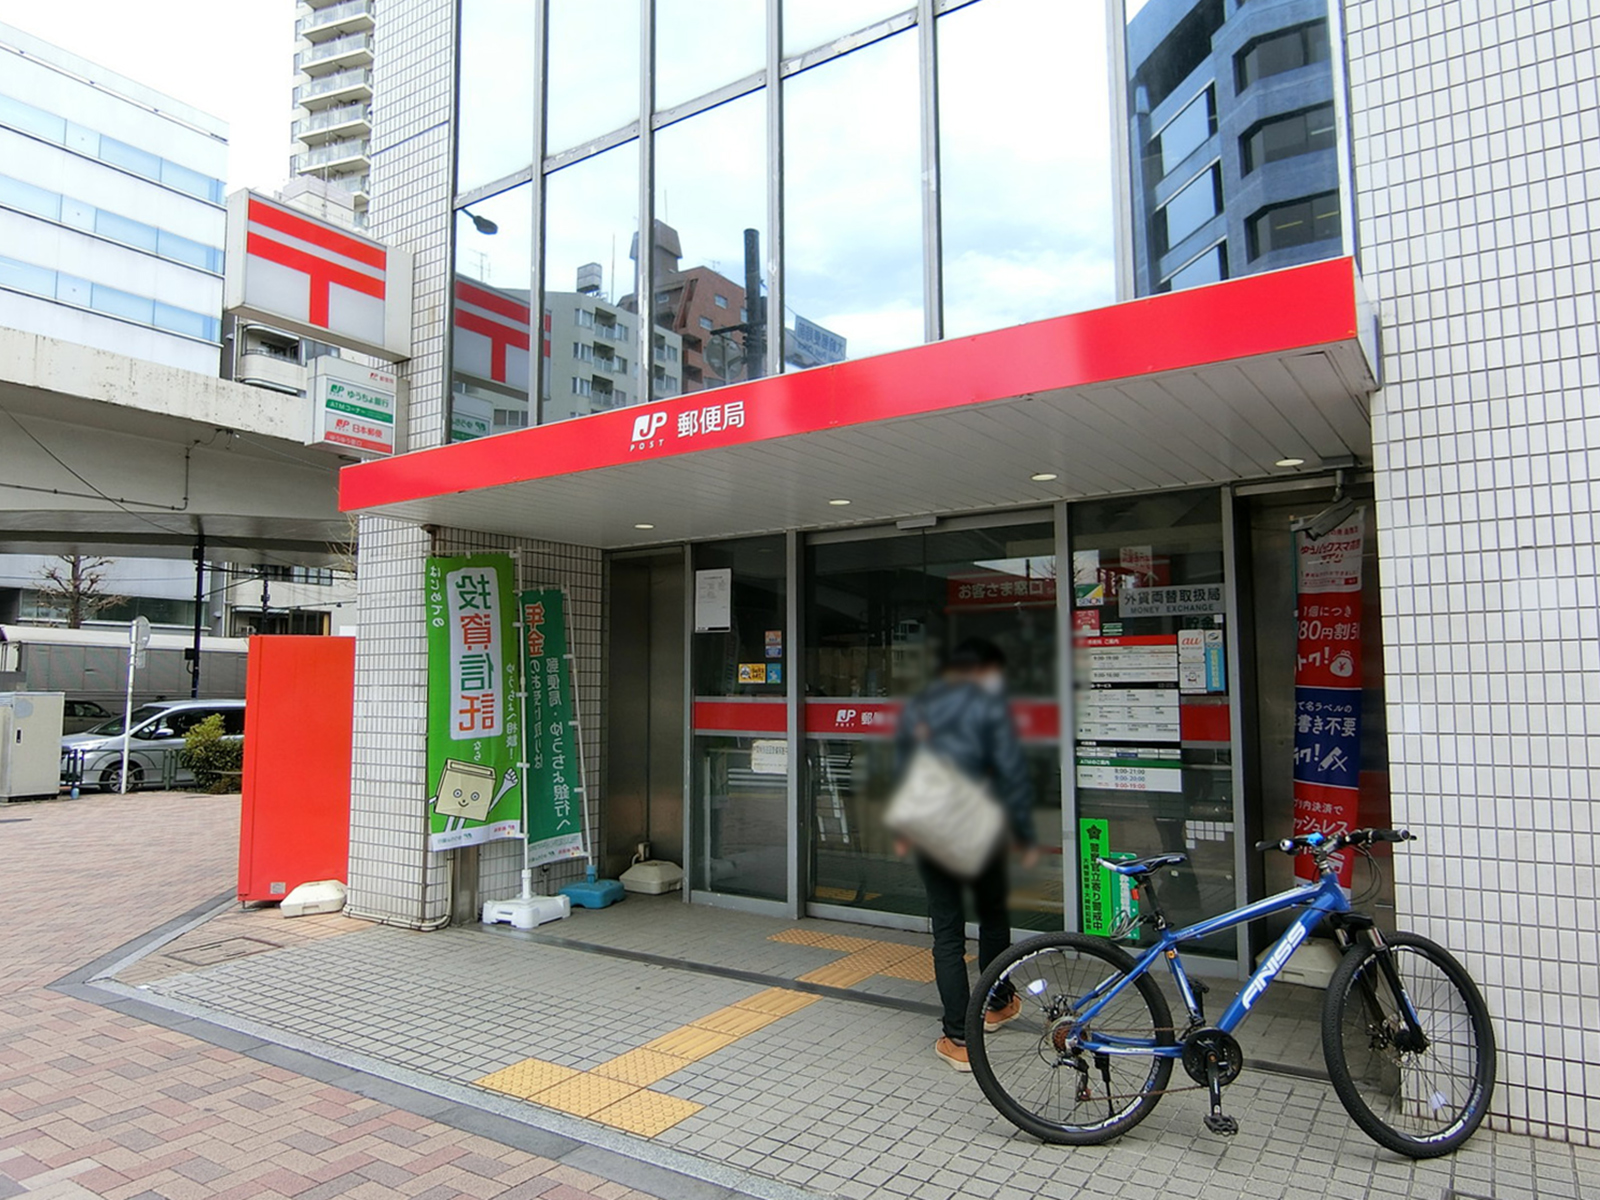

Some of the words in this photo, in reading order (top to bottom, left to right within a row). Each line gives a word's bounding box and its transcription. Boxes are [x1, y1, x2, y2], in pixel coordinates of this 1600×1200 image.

[347, 390, 389, 408] ゆうちょ銀行
[632, 411, 668, 442] JP
[677, 401, 745, 438] 郵便局
[352, 423, 383, 438] 日本郵便
[629, 439, 664, 452] POST
[958, 580, 1044, 599] お客さま窓口
[1124, 587, 1221, 606] 外貨両替取扱局
[1130, 605, 1160, 614] MONEY
[1166, 603, 1214, 613] EXCHANGE
[1181, 636, 1201, 646] au
[836, 709, 857, 723] JP
[1242, 920, 1307, 1010] FINISS
